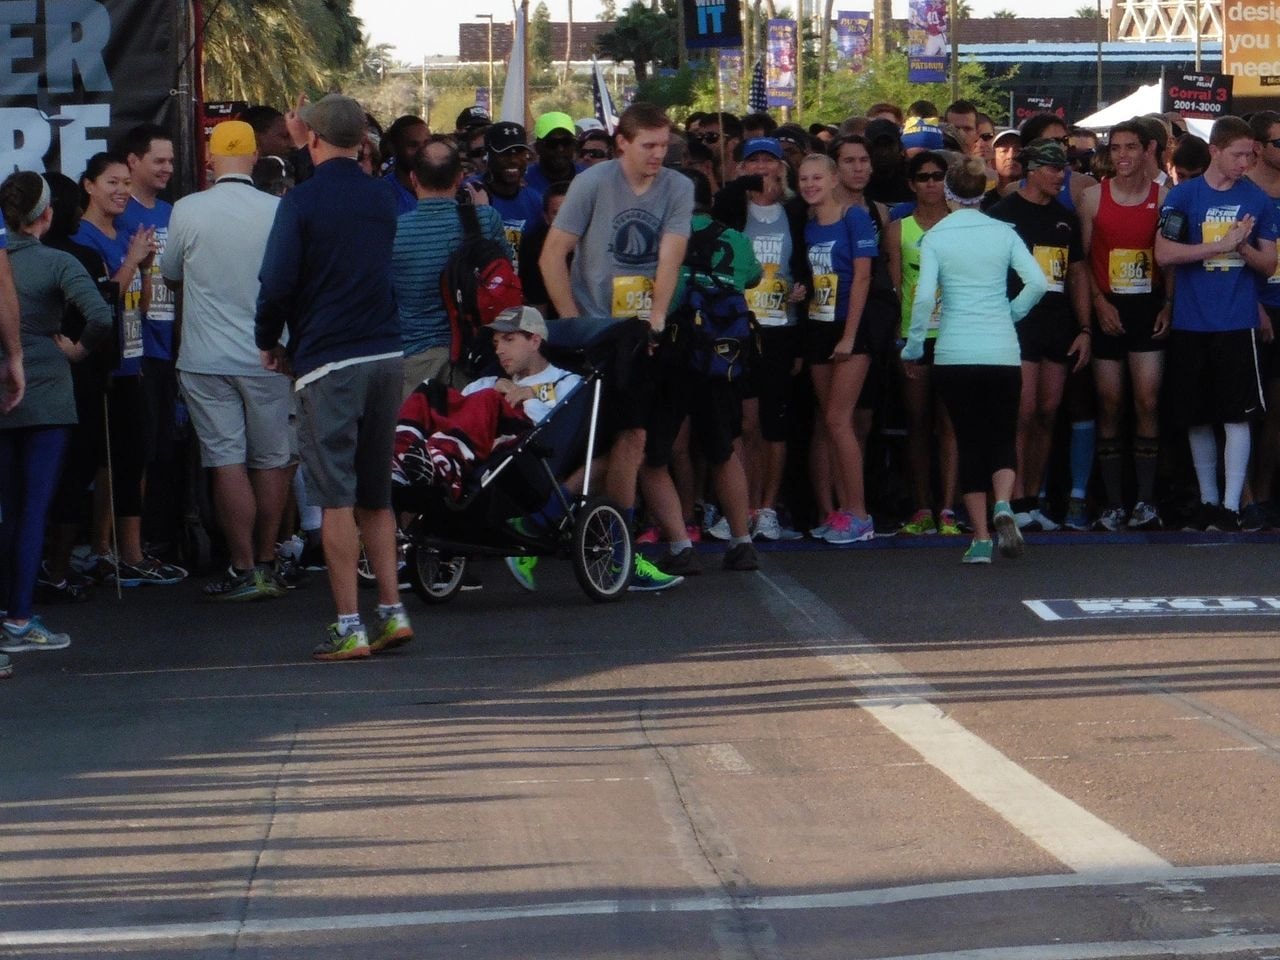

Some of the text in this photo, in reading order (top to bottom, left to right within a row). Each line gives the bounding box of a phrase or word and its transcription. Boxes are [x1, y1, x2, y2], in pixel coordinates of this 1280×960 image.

[697, 5, 727, 35] IT
[1229, 32, 1271, 53] you
[1168, 86, 1228, 101] Corral 3
[1174, 100, 1222, 112] 2001-3000
[752, 240, 782, 253] RUN
[1119, 262, 1143, 279] 386
[626, 291, 653, 309] 936
[753, 291, 783, 308] 3057
